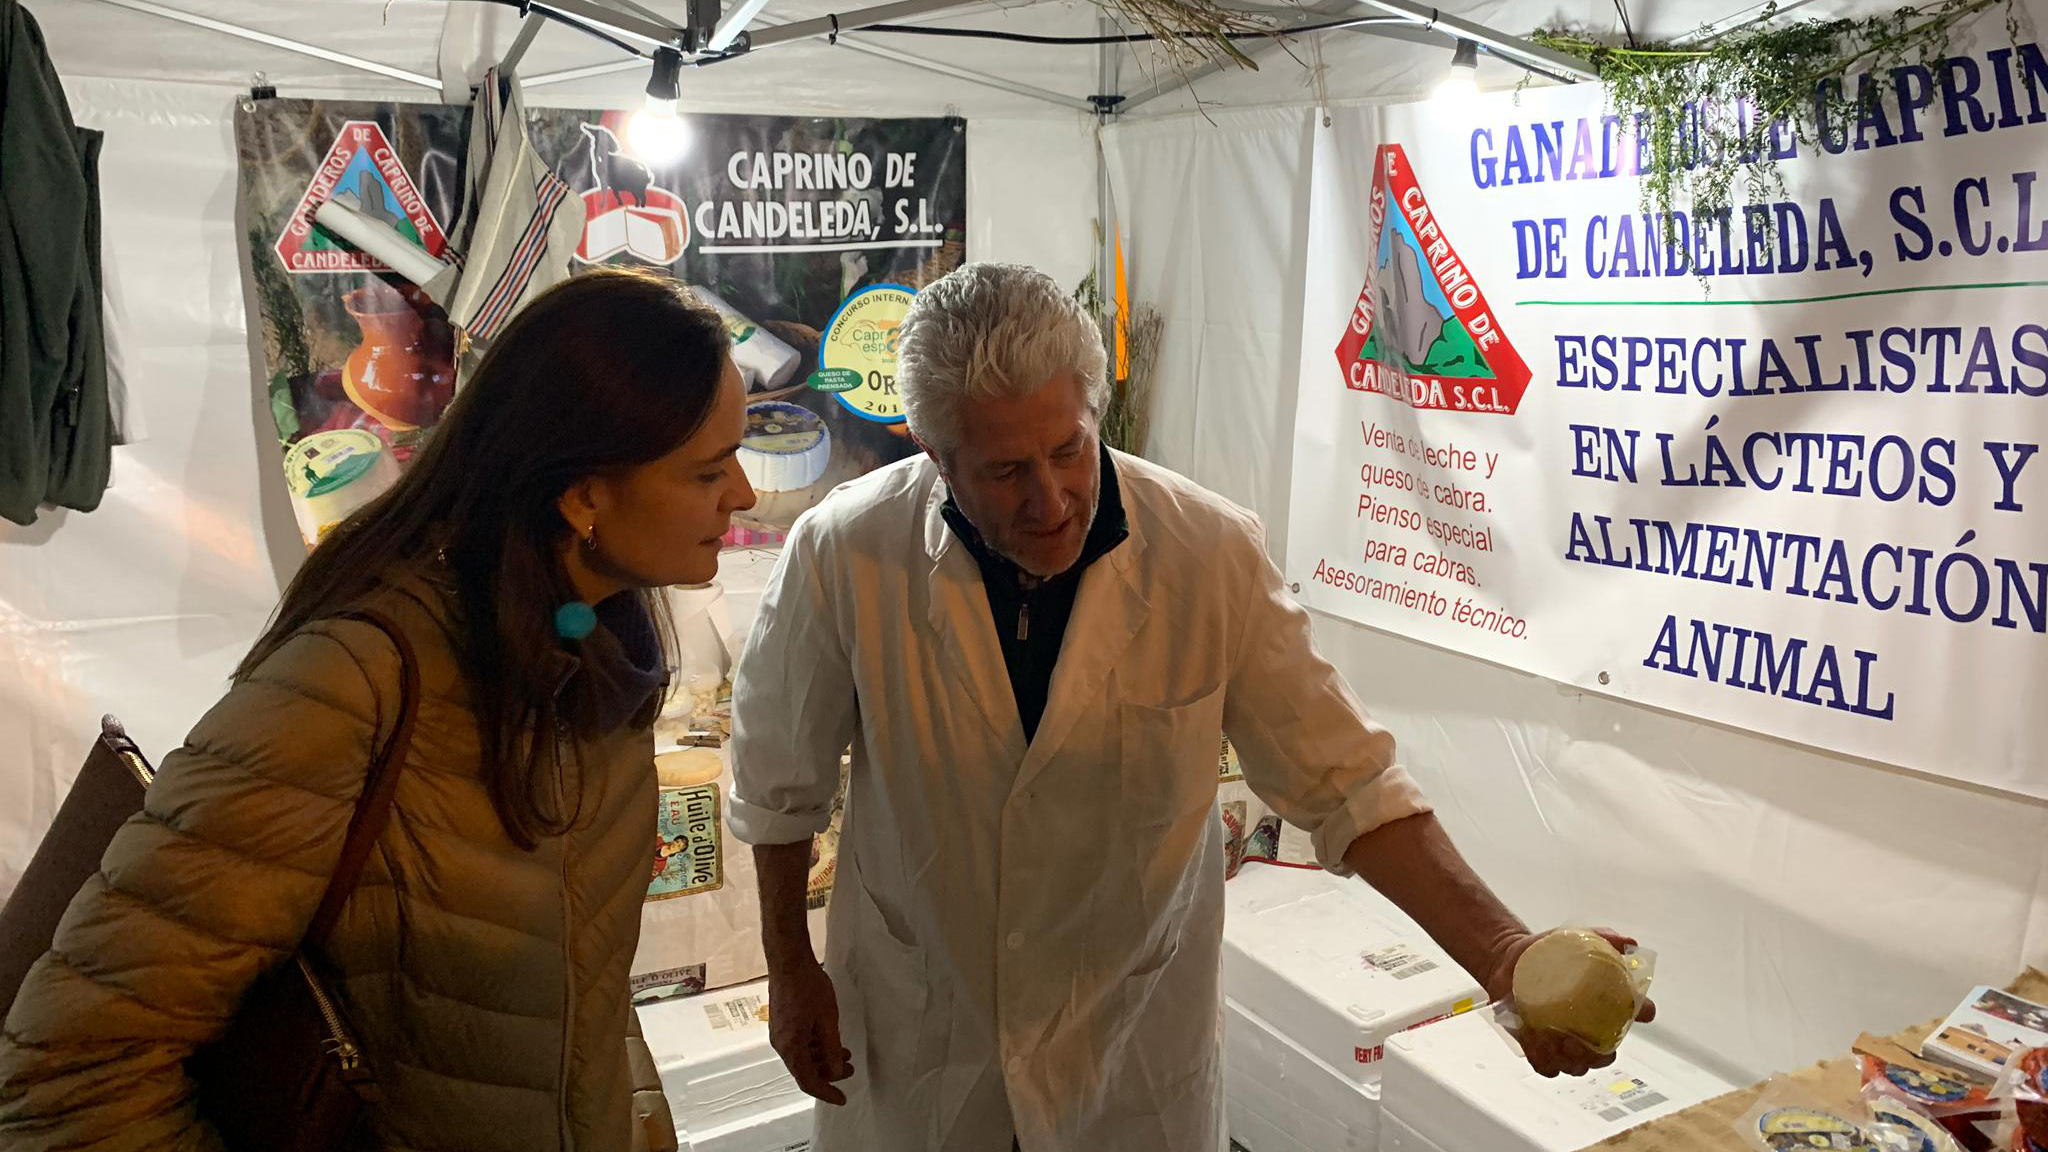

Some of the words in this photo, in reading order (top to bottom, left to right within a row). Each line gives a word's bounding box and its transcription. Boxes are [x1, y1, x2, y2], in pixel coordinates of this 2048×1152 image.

[352, 127, 371, 142] DE
[374, 148, 422, 215] CAPRINO
[414, 215, 433, 236] DE
[727, 151, 873, 190] CAPRINO
[885, 152, 917, 188] DE
[695, 200, 881, 240] CANDELEDA,
[894, 198, 944, 234] S.L.
[1512, 217, 1567, 279] DE
[1585, 198, 1874, 278] CANDELEDA,
[292, 252, 387, 269] CANDELED
[1402, 187, 1478, 309] CAPRINO
[1467, 312, 1499, 351] DE
[830, 298, 870, 342] CONCURSO
[1555, 324, 2048, 397] ESPECIALISTAS
[1453, 386, 1510, 412] S.C.L.
[1361, 421, 1405, 454] Venta
[1421, 439, 1476, 471] leche
[1485, 452, 1498, 479] y
[1569, 424, 1640, 483] EN
[1656, 414, 1956, 506] LÁCTEOS
[1984, 441, 2038, 512] Y
[1361, 463, 1413, 491] queso
[1434, 483, 1492, 512] cabra.
[1358, 494, 1421, 530] Pienso
[1427, 517, 1493, 552] especial
[1364, 539, 1407, 566] para
[1413, 551, 1481, 587] cabras.
[1565, 512, 2048, 633] ALIMENTACIÓN
[1313, 559, 1447, 616] Asesoramiento
[1452, 597, 1528, 640] técnico.
[1643, 615, 1895, 720] ANIMAL
[670, 801, 681, 826] EAU
[678, 790, 712, 833] Huile
[692, 836, 715, 884] d'Olive
[1354, 1045, 1372, 1063] VERY
